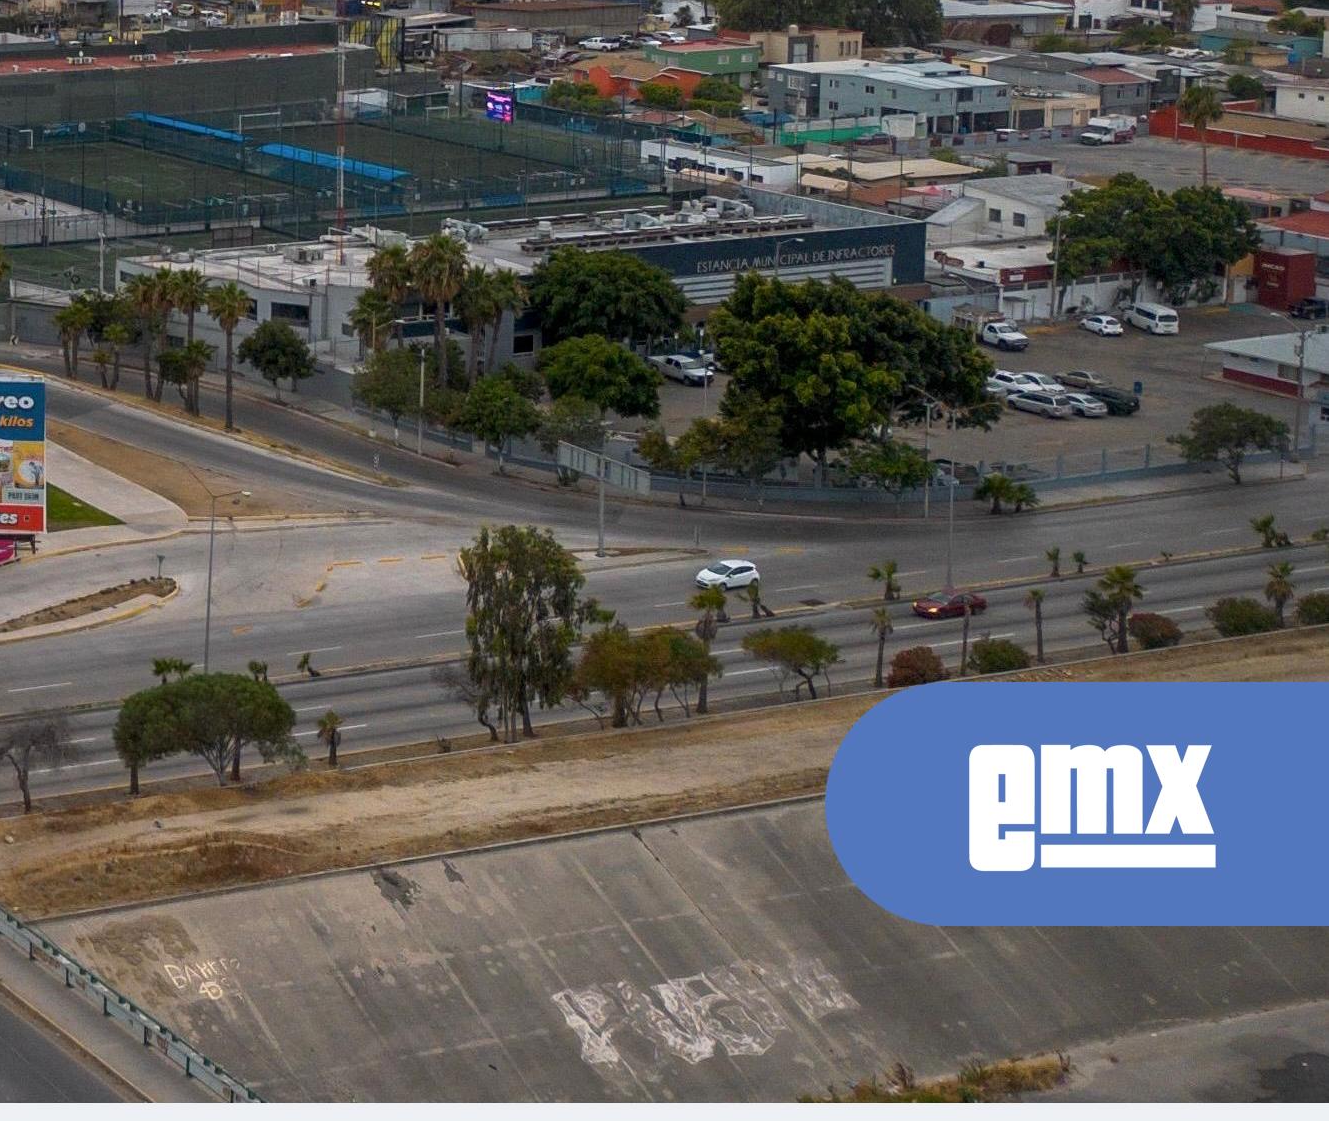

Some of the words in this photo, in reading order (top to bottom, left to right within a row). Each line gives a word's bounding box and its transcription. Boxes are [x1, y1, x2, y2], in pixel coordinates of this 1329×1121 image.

[696, 258, 750, 273] ESTANCIA
[752, 253, 810, 270] MUNCIPAL
[812, 250, 828, 263] DE
[828, 244, 895, 261] INFRACTORES
